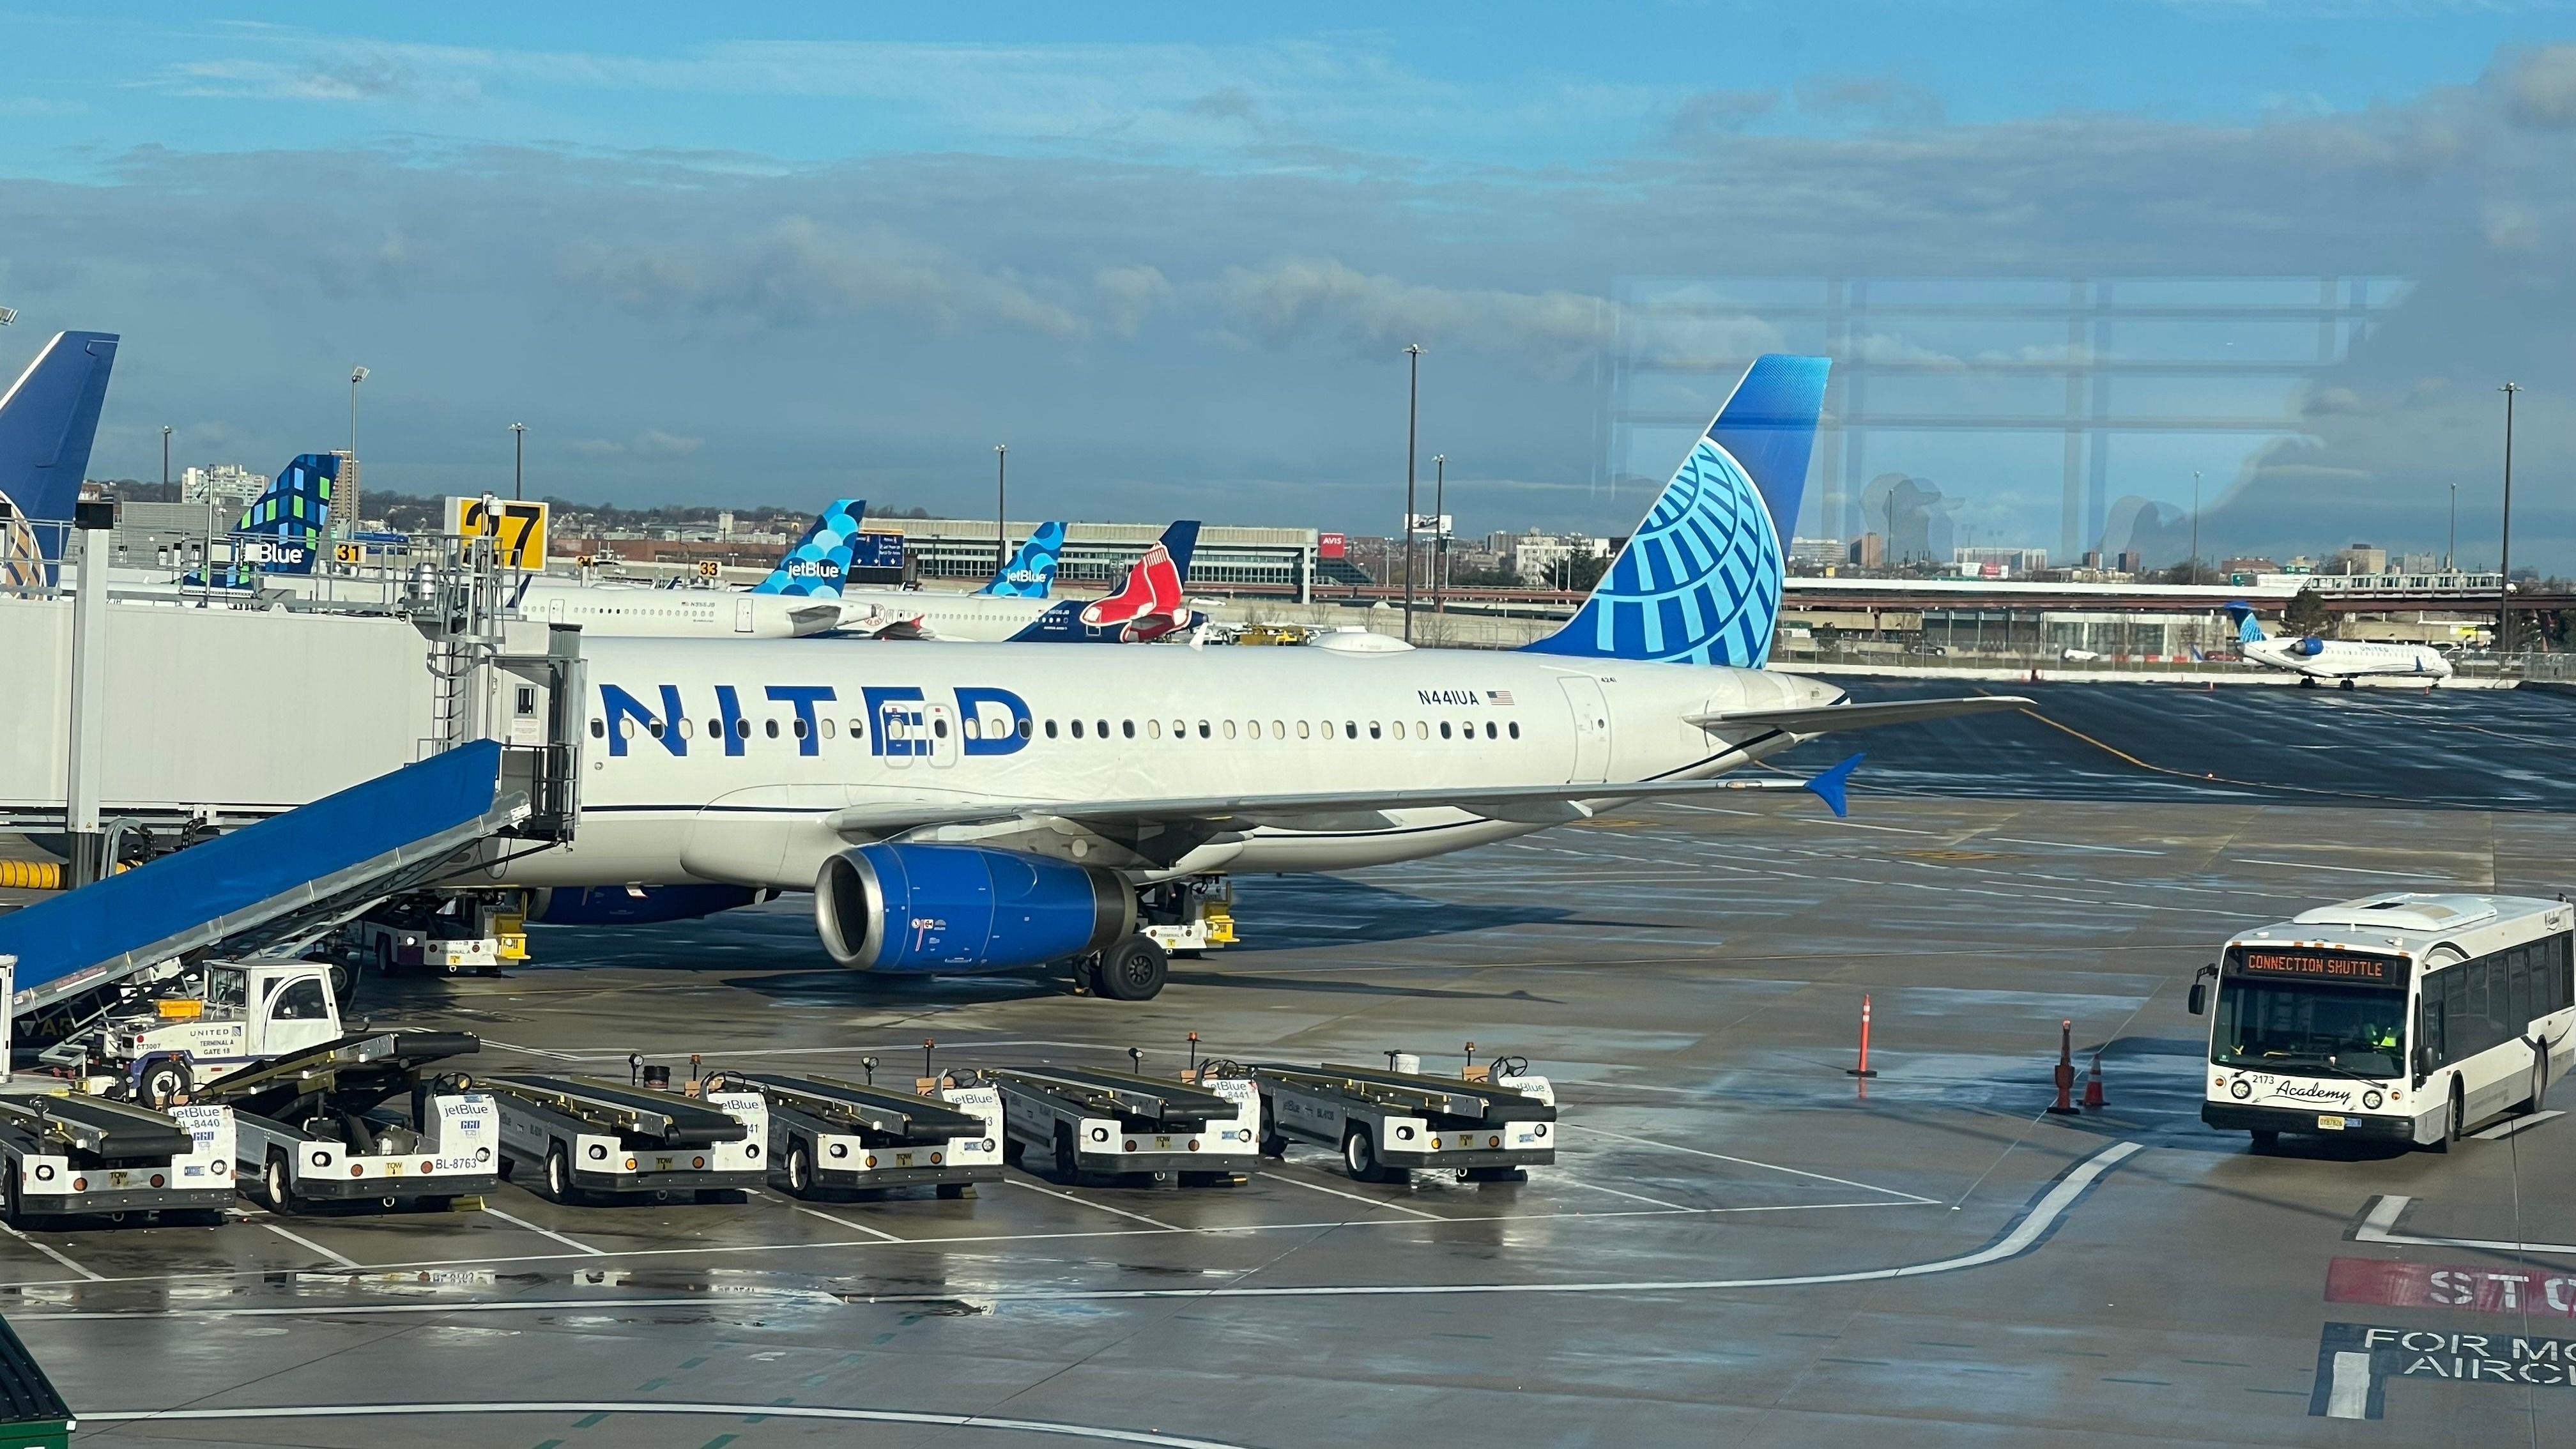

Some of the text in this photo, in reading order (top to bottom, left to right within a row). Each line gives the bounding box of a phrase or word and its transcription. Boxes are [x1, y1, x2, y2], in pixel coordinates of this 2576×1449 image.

[463, 502, 540, 566] 27
[338, 544, 360, 561] 31
[700, 562, 718, 576] 33
[787, 561, 839, 579] jetBlue
[1006, 569, 1046, 583] jetBlue
[599, 684, 1034, 756] NITED
[2248, 954, 2382, 977] CONNECTION SHUTTLE
[2253, 1075, 2274, 1084] 2173
[2276, 1080, 2352, 1105] Academy
[172, 1107, 220, 1118] jetBlue
[443, 1105, 489, 1117] jetBlue
[178, 1119, 220, 1129] L-8440
[436, 1158, 477, 1169] BL-8763
[2365, 1328, 2576, 1361] FOR M
[2404, 1356, 2576, 1386] AIRC
